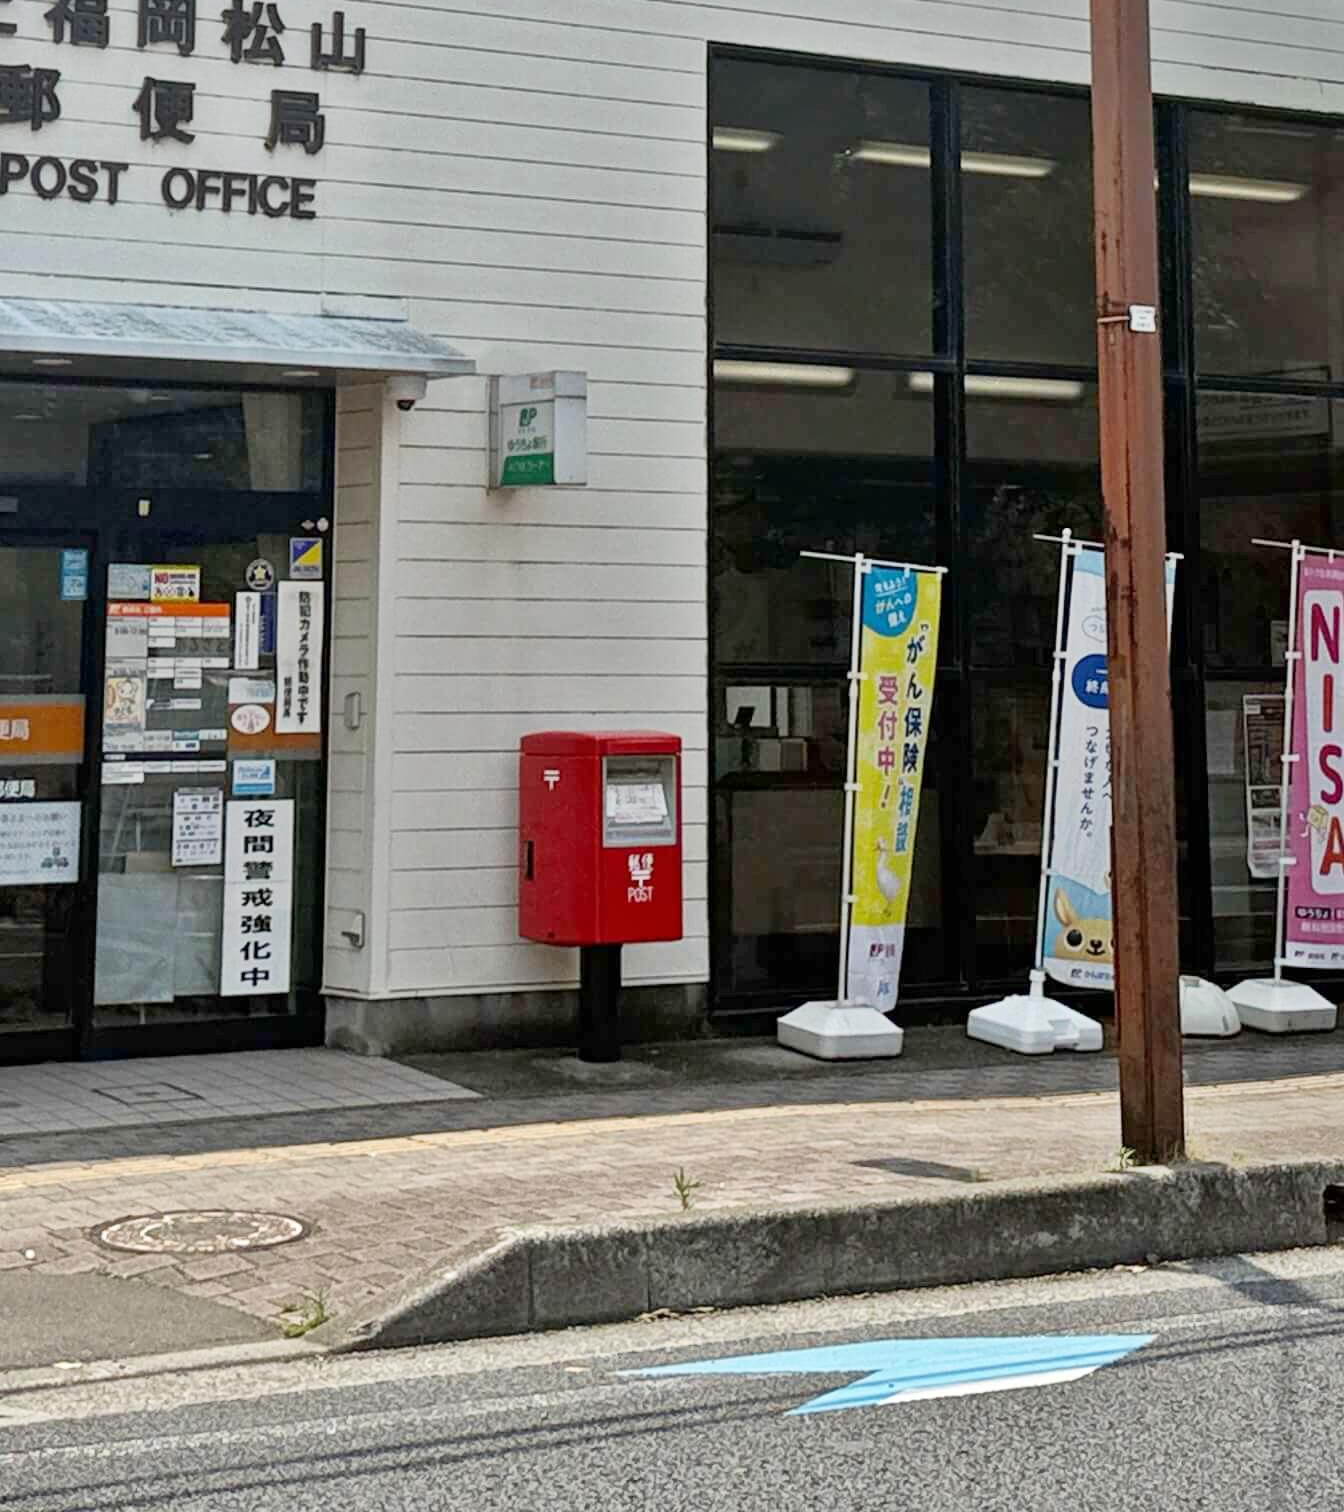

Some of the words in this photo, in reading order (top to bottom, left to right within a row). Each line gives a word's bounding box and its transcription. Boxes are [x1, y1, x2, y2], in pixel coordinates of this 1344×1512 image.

[161, 168, 316, 219] OFFICE
[240, 808, 275, 987] 夜間警戒強化中
[627, 887, 654, 903] POST
